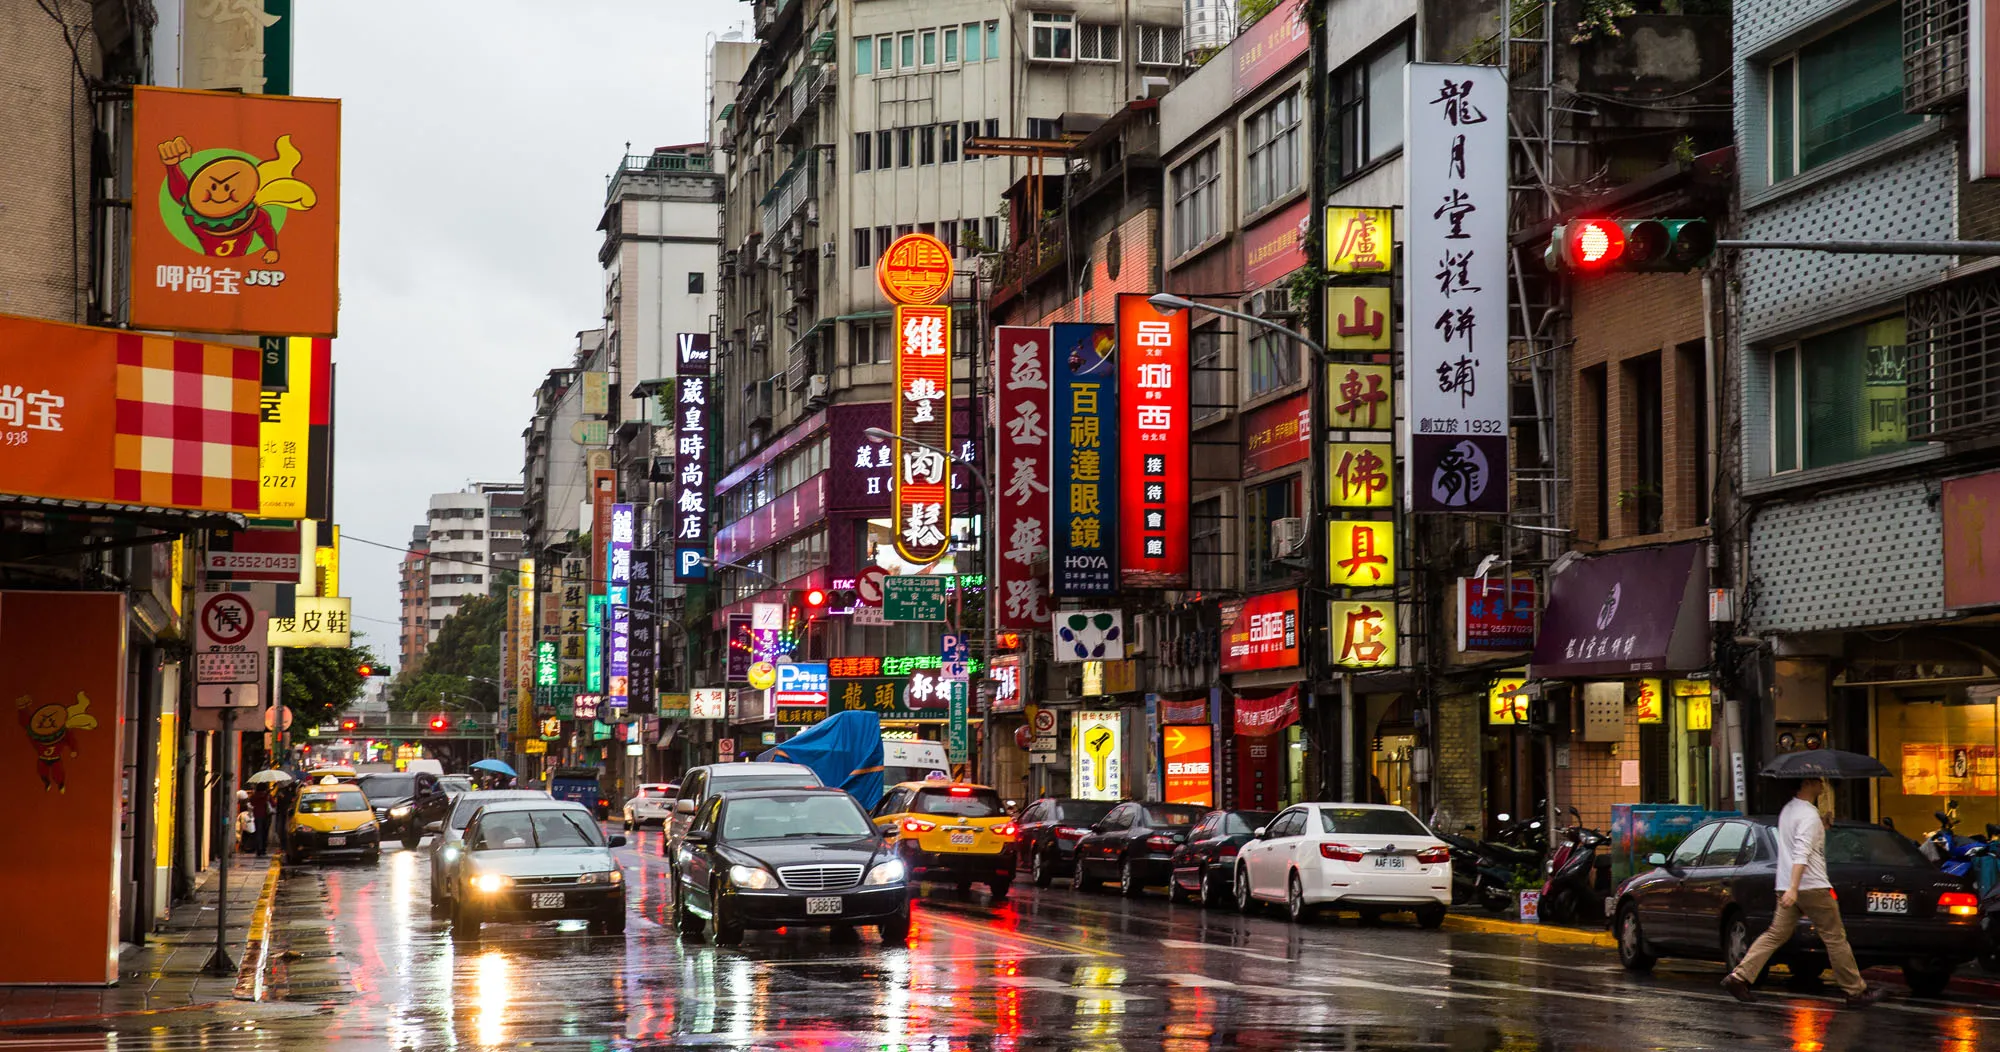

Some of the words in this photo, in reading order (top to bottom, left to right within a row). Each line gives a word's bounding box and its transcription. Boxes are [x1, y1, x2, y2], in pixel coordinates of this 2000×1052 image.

[244, 269, 286, 288] JSP
[1420, 418, 1459, 433] 創立於
[1465, 418, 1502, 433] 1932
[1069, 382, 1101, 549] 百視達眼鏡
[1146, 457, 1162, 555] 接待會館
[682, 551, 700, 575] P
[1063, 555, 1109, 569] HOYA
[214, 605, 242, 632] 停
[778, 665, 800, 692] P
[841, 682, 897, 711] 龍頭
